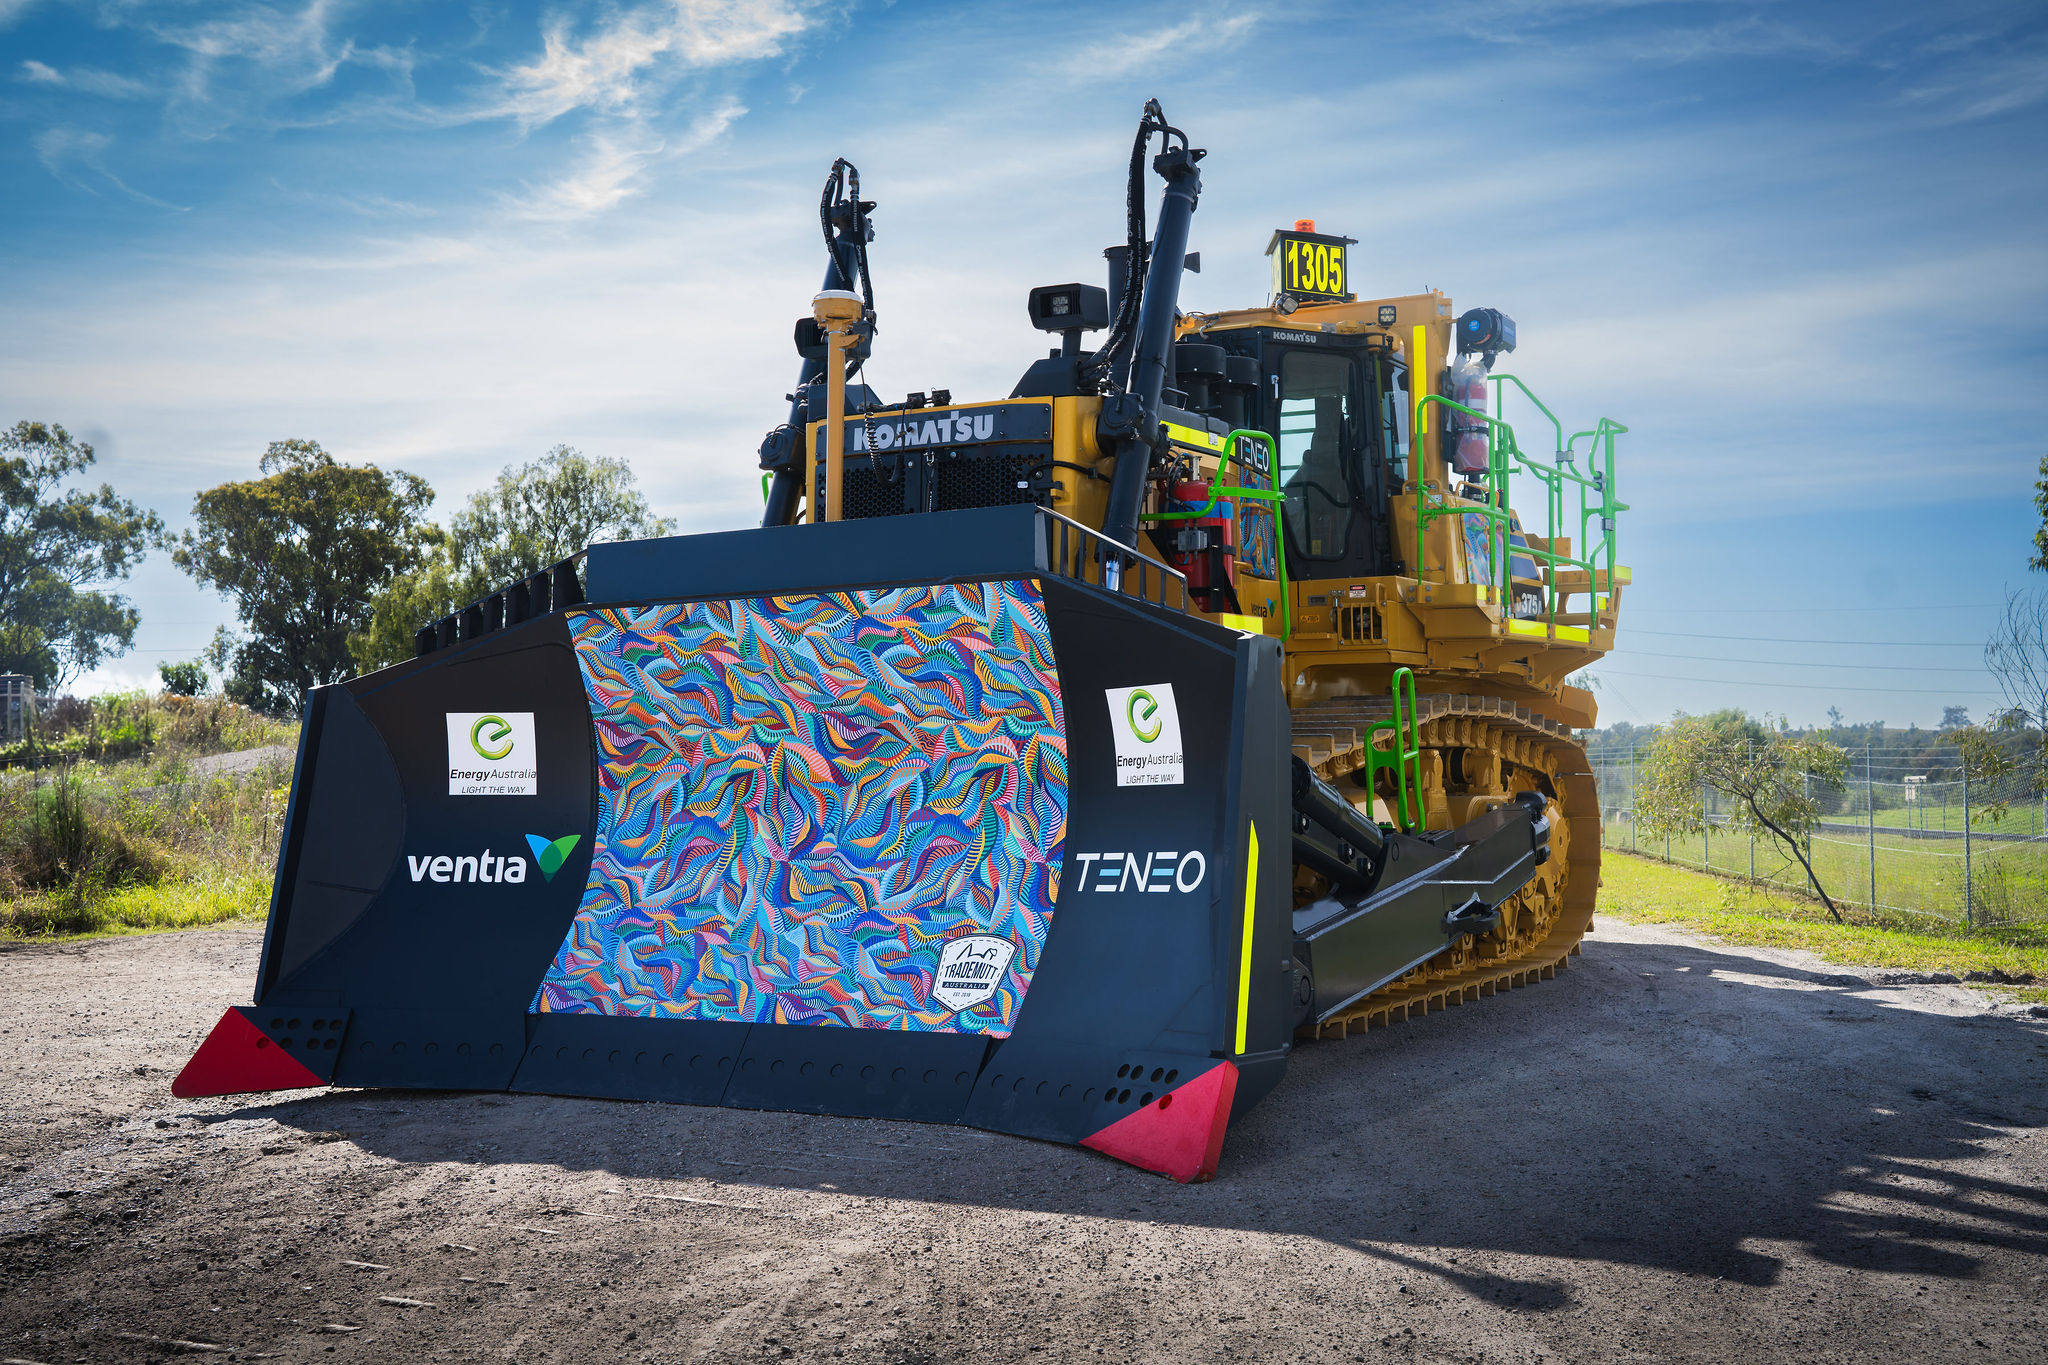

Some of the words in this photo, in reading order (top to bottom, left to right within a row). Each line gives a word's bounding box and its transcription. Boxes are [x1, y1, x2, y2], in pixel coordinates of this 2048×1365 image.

[1288, 241, 1342, 294] 1305
[1273, 332, 1317, 343] KOMATSU
[853, 410, 994, 451] KOMATSU
[1238, 436, 1269, 472] TENEO
[1126, 775, 1145, 784] LIGHT
[1147, 774, 1159, 783] THE
[1161, 774, 1175, 783] WAY
[407, 848, 527, 883] ventia
[1076, 850, 1206, 893] TENEO
[944, 961, 998, 979] TRADEMUTT
